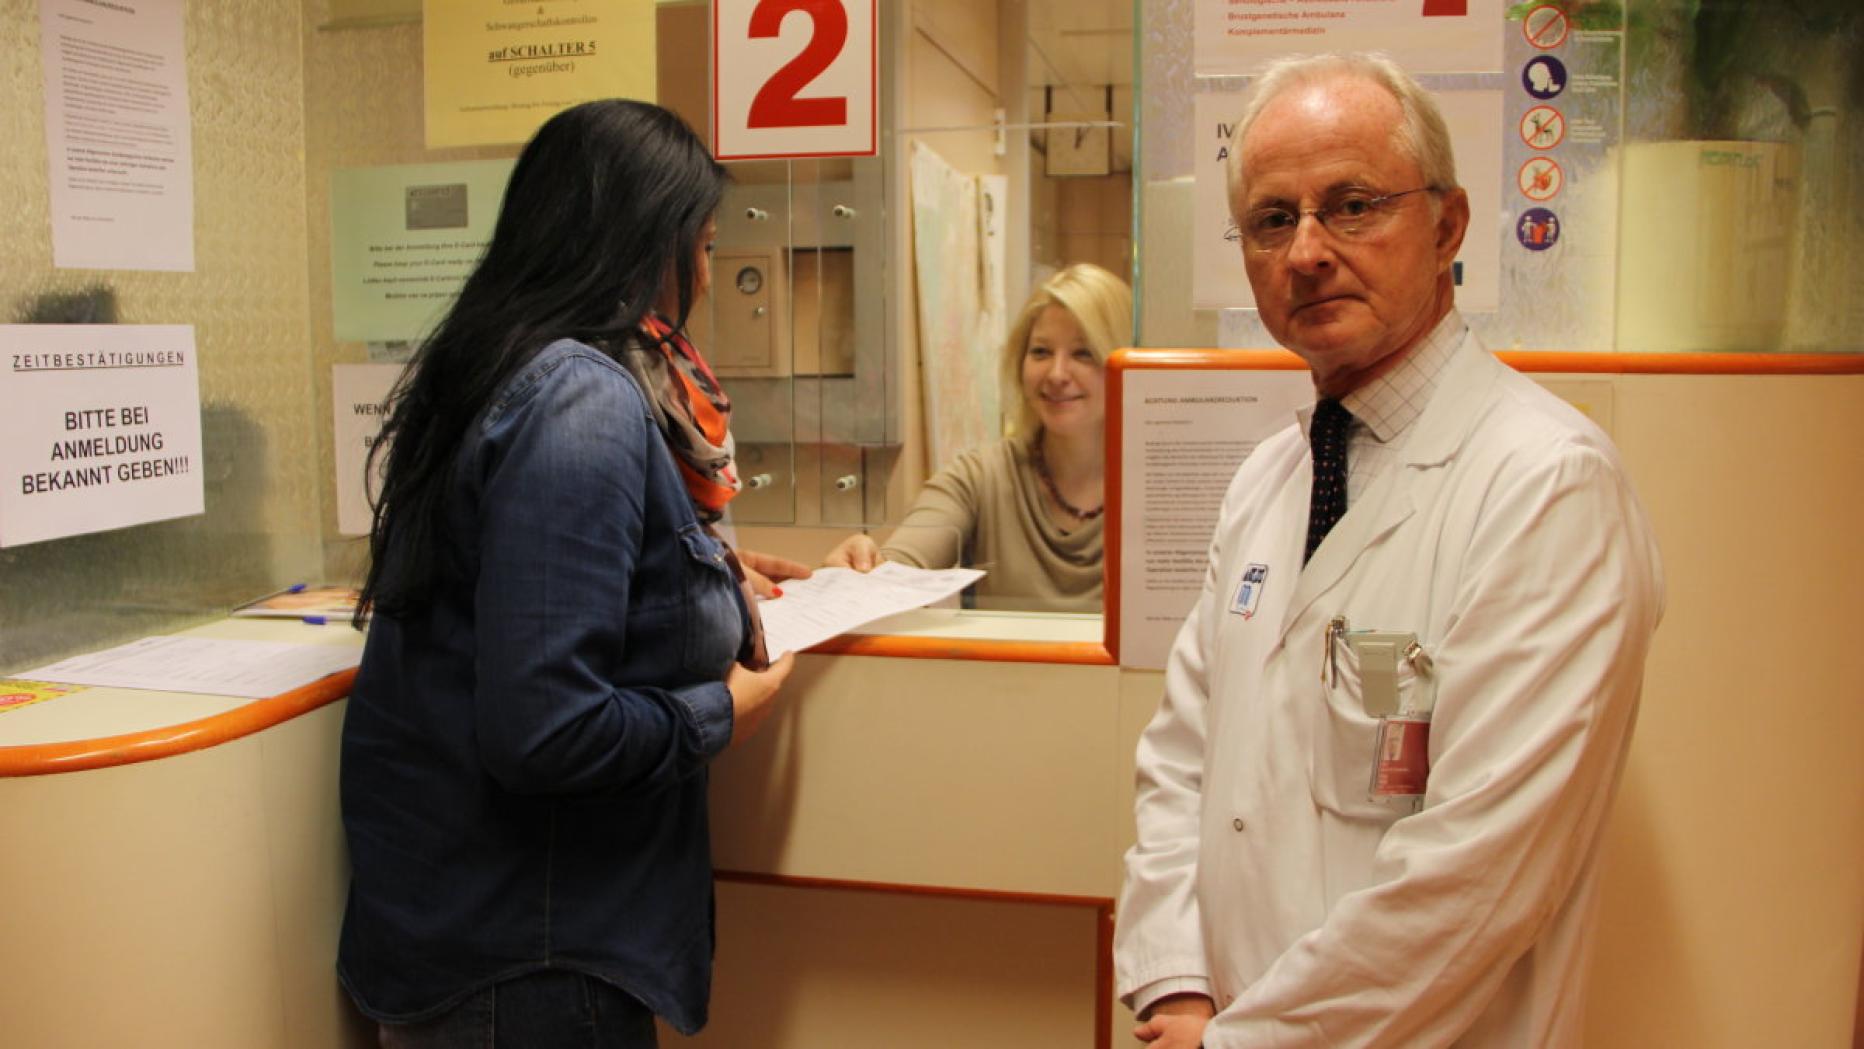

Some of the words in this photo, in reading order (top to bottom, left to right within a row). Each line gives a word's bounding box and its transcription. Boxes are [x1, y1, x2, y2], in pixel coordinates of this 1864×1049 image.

[488, 47, 508, 62] auf
[510, 41, 585, 59] SCHALTER
[507, 60, 576, 79] (gegenüber)
[747, 0, 848, 129] 2
[13, 350, 185, 371] ZEITBESTÄTIGUNGEN
[65, 408, 115, 430] BITTE
[121, 406, 149, 425] BEI
[353, 403, 391, 416] WENN
[51, 432, 164, 461] ANMELDUNG
[22, 465, 112, 495] BEKANNT
[117, 456, 189, 482] GEBEN!!!
